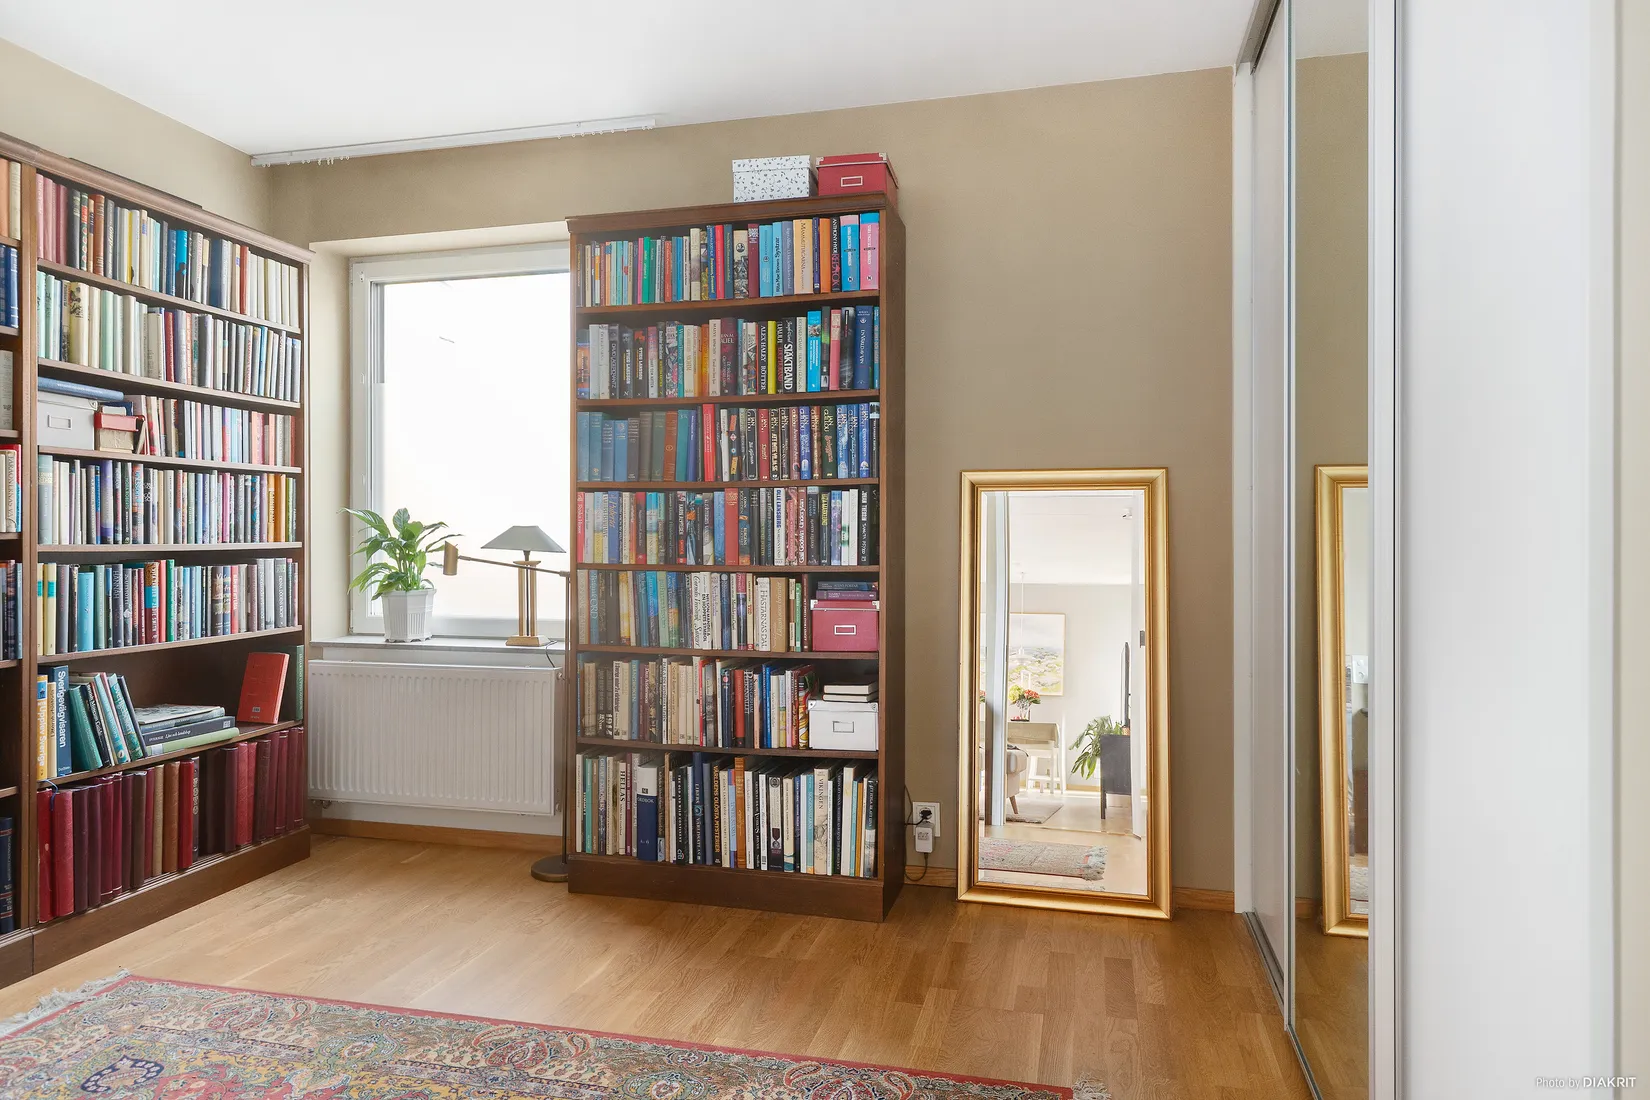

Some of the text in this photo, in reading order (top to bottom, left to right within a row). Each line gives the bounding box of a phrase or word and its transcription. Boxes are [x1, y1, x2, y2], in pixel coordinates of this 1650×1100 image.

[38, 702, 46, 766] Upplev Sverige
[57, 670, 66, 748] Sverigevägvisaren
